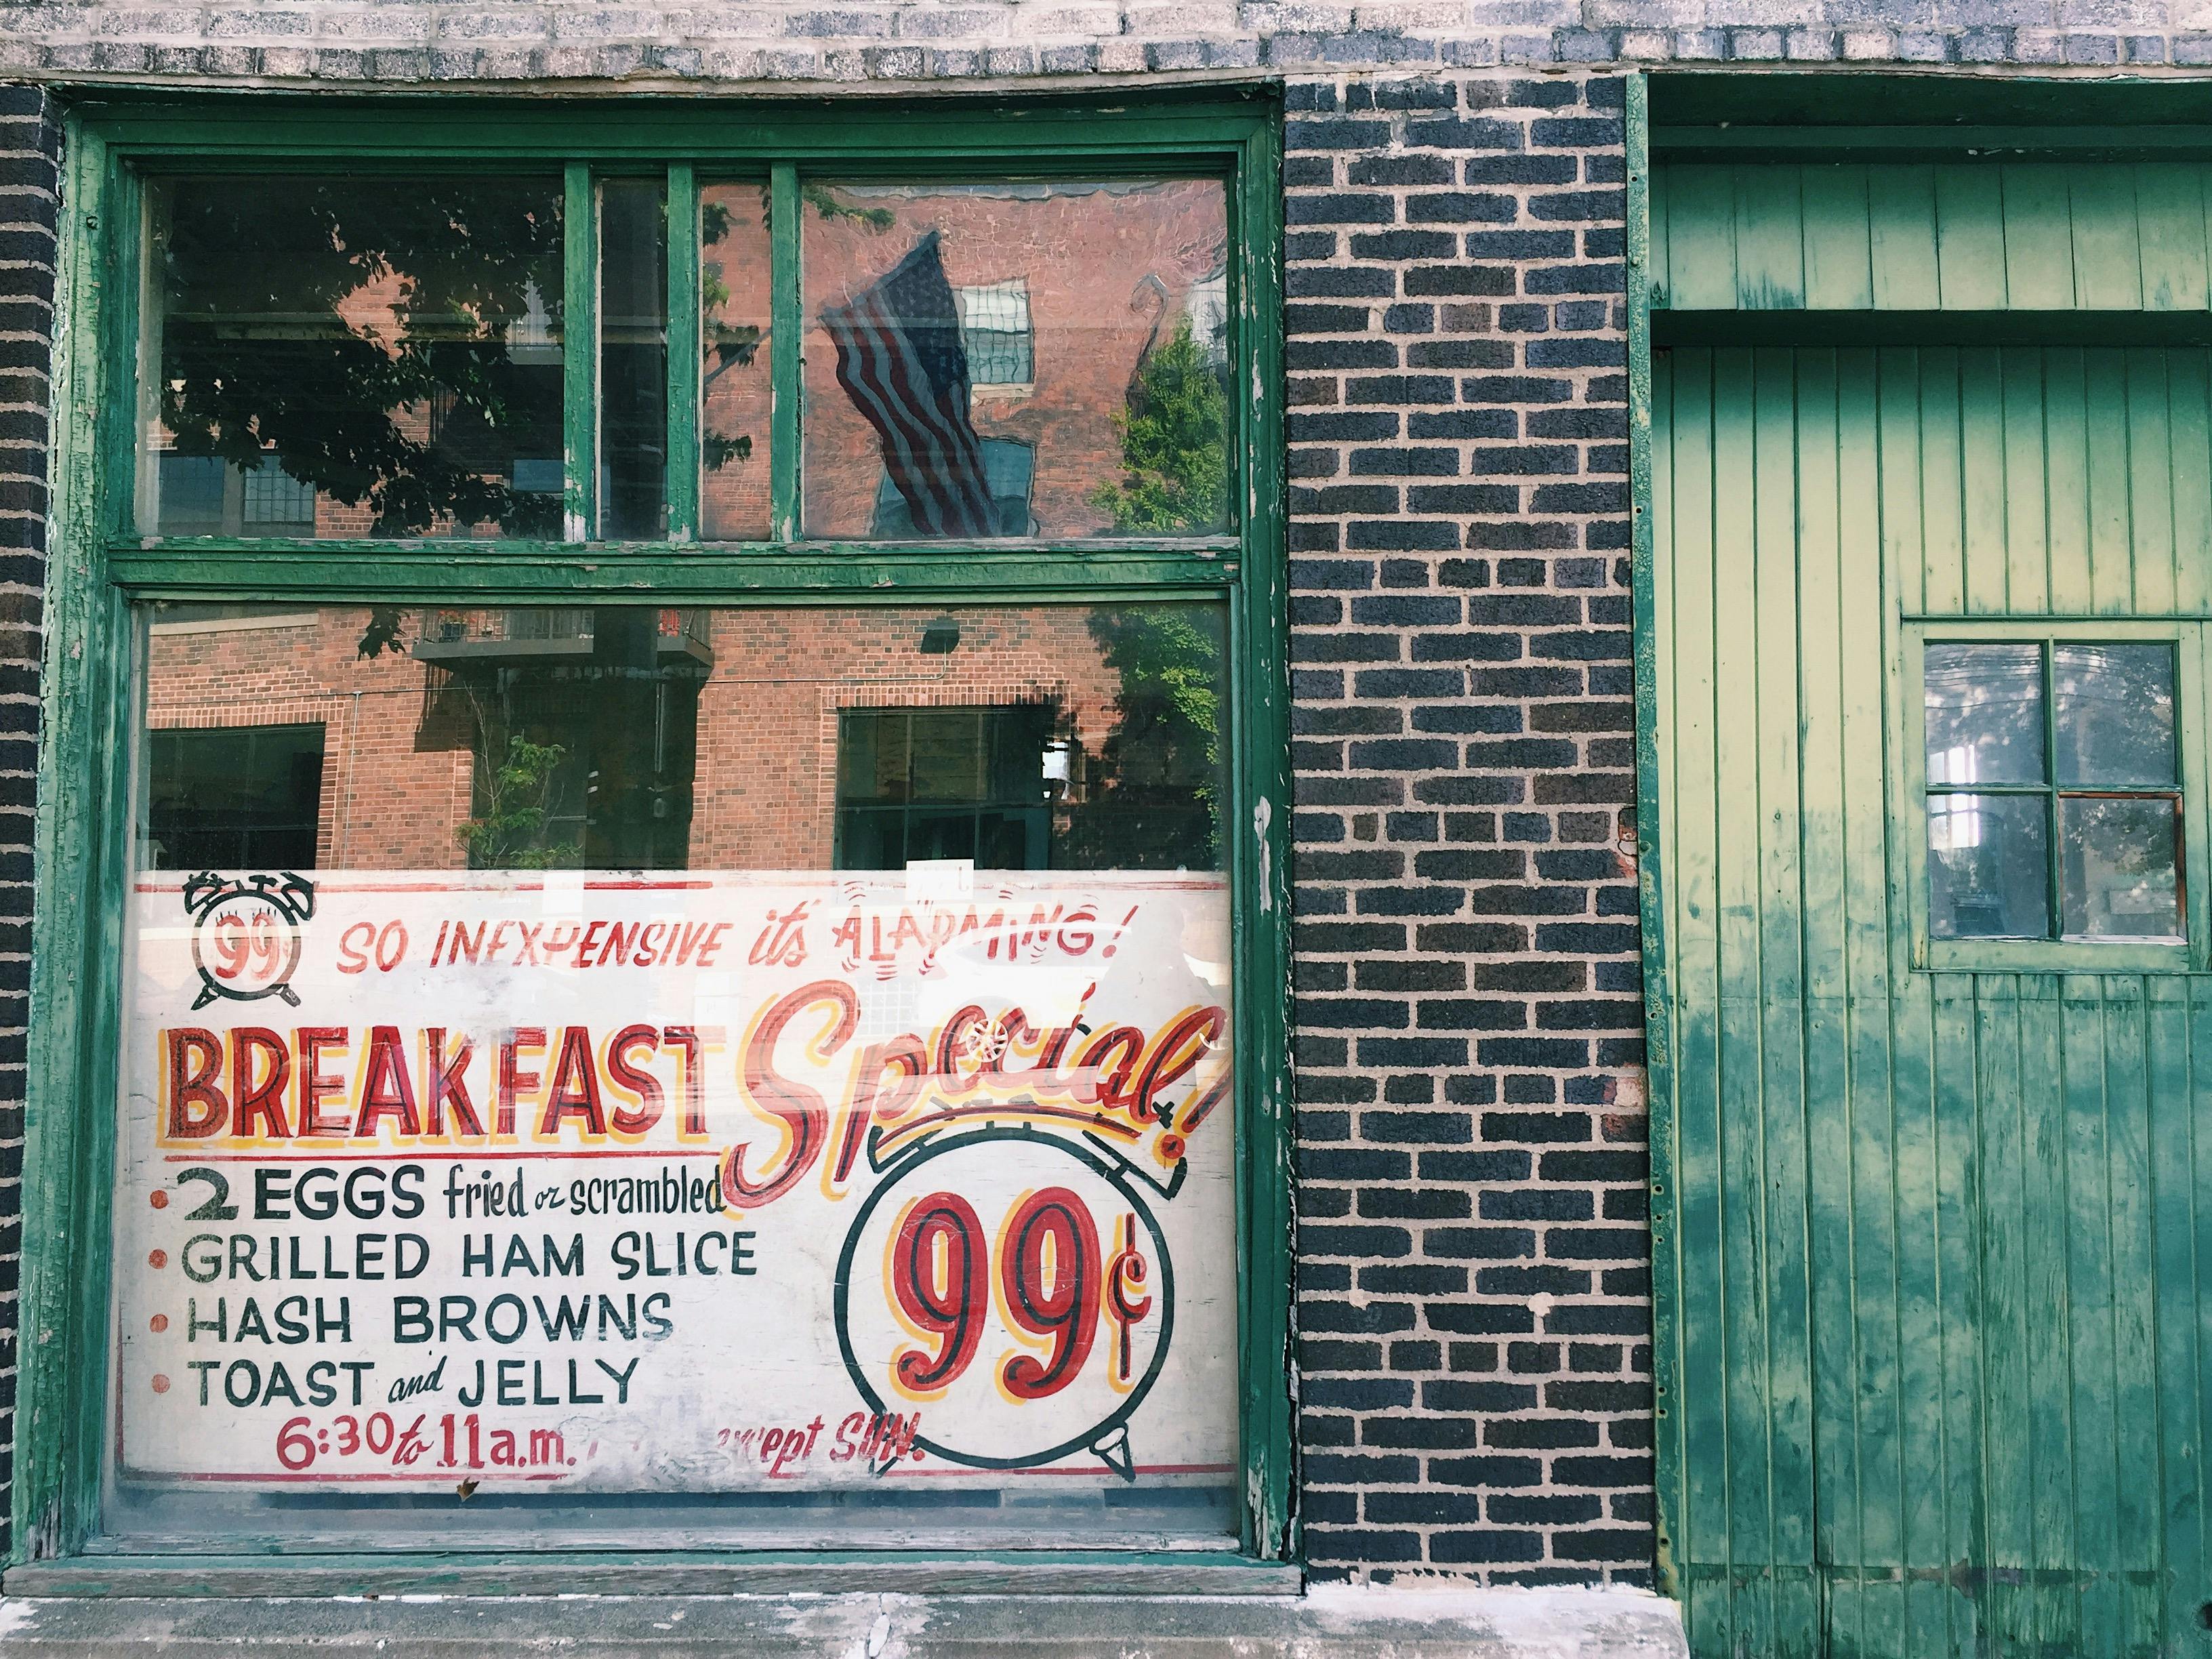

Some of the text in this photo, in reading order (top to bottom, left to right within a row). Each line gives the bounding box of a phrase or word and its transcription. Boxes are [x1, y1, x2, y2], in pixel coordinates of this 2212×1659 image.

[335, 919, 409, 975] SO
[429, 919, 735, 968] INEXPENSIVE
[159, 979, 1233, 1210] BREAKFAST Special!
[176, 1164, 727, 1221] 2 EGGS fried or scrambled
[180, 1231, 758, 1283] GRILLED HAM SLICE
[186, 1292, 676, 1345] HASH BROWNS
[186, 1353, 640, 1408] TOAST and JELLY
[276, 1412, 395, 1470] 6:30
[391, 1414, 434, 1466] to
[828, 1410, 926, 1462] SUN.
